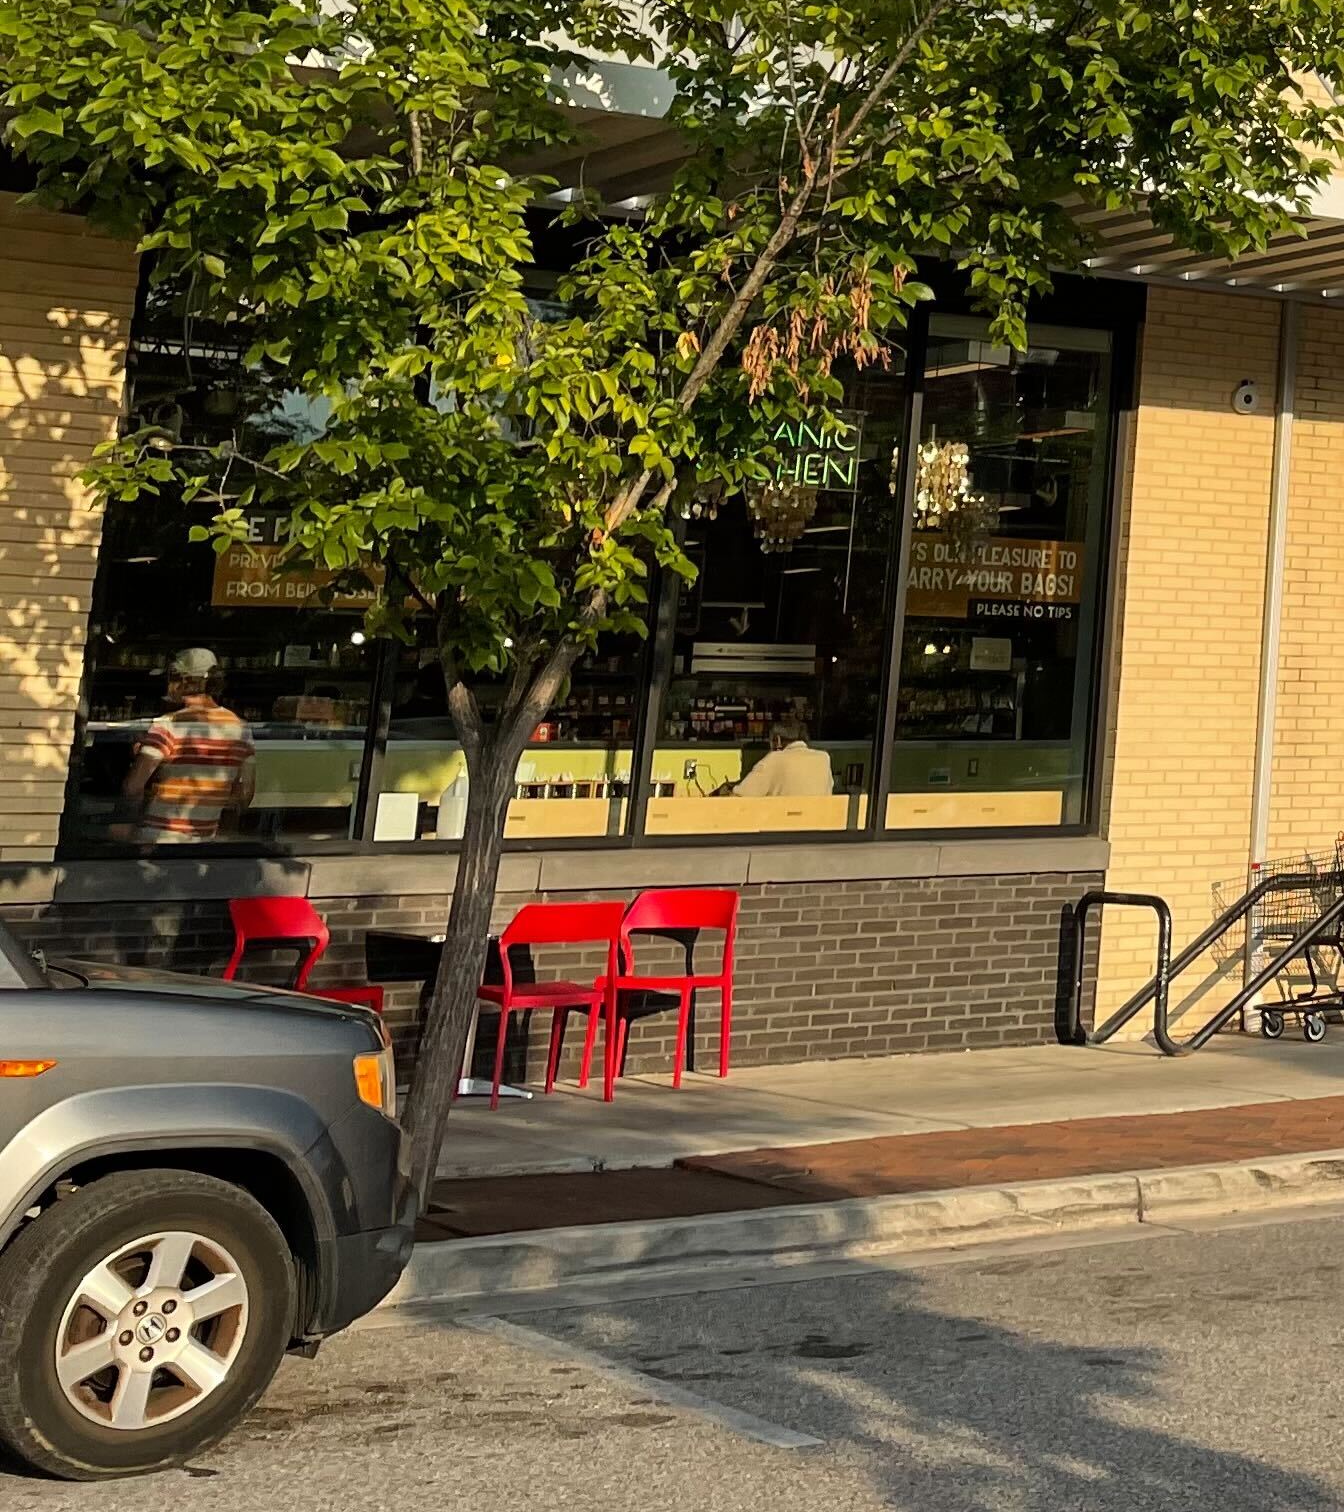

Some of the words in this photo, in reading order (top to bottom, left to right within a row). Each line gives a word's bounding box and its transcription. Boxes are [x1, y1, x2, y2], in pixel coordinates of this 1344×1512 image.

[774, 421, 857, 452] ANIC
[1058, 550, 1077, 570] TO
[907, 566, 959, 591] ARRY
[226, 582, 281, 600] FROM
[976, 603, 1021, 617] PLEASE
[1024, 603, 1043, 619] NO
[1047, 605, 1073, 620] TIPS
